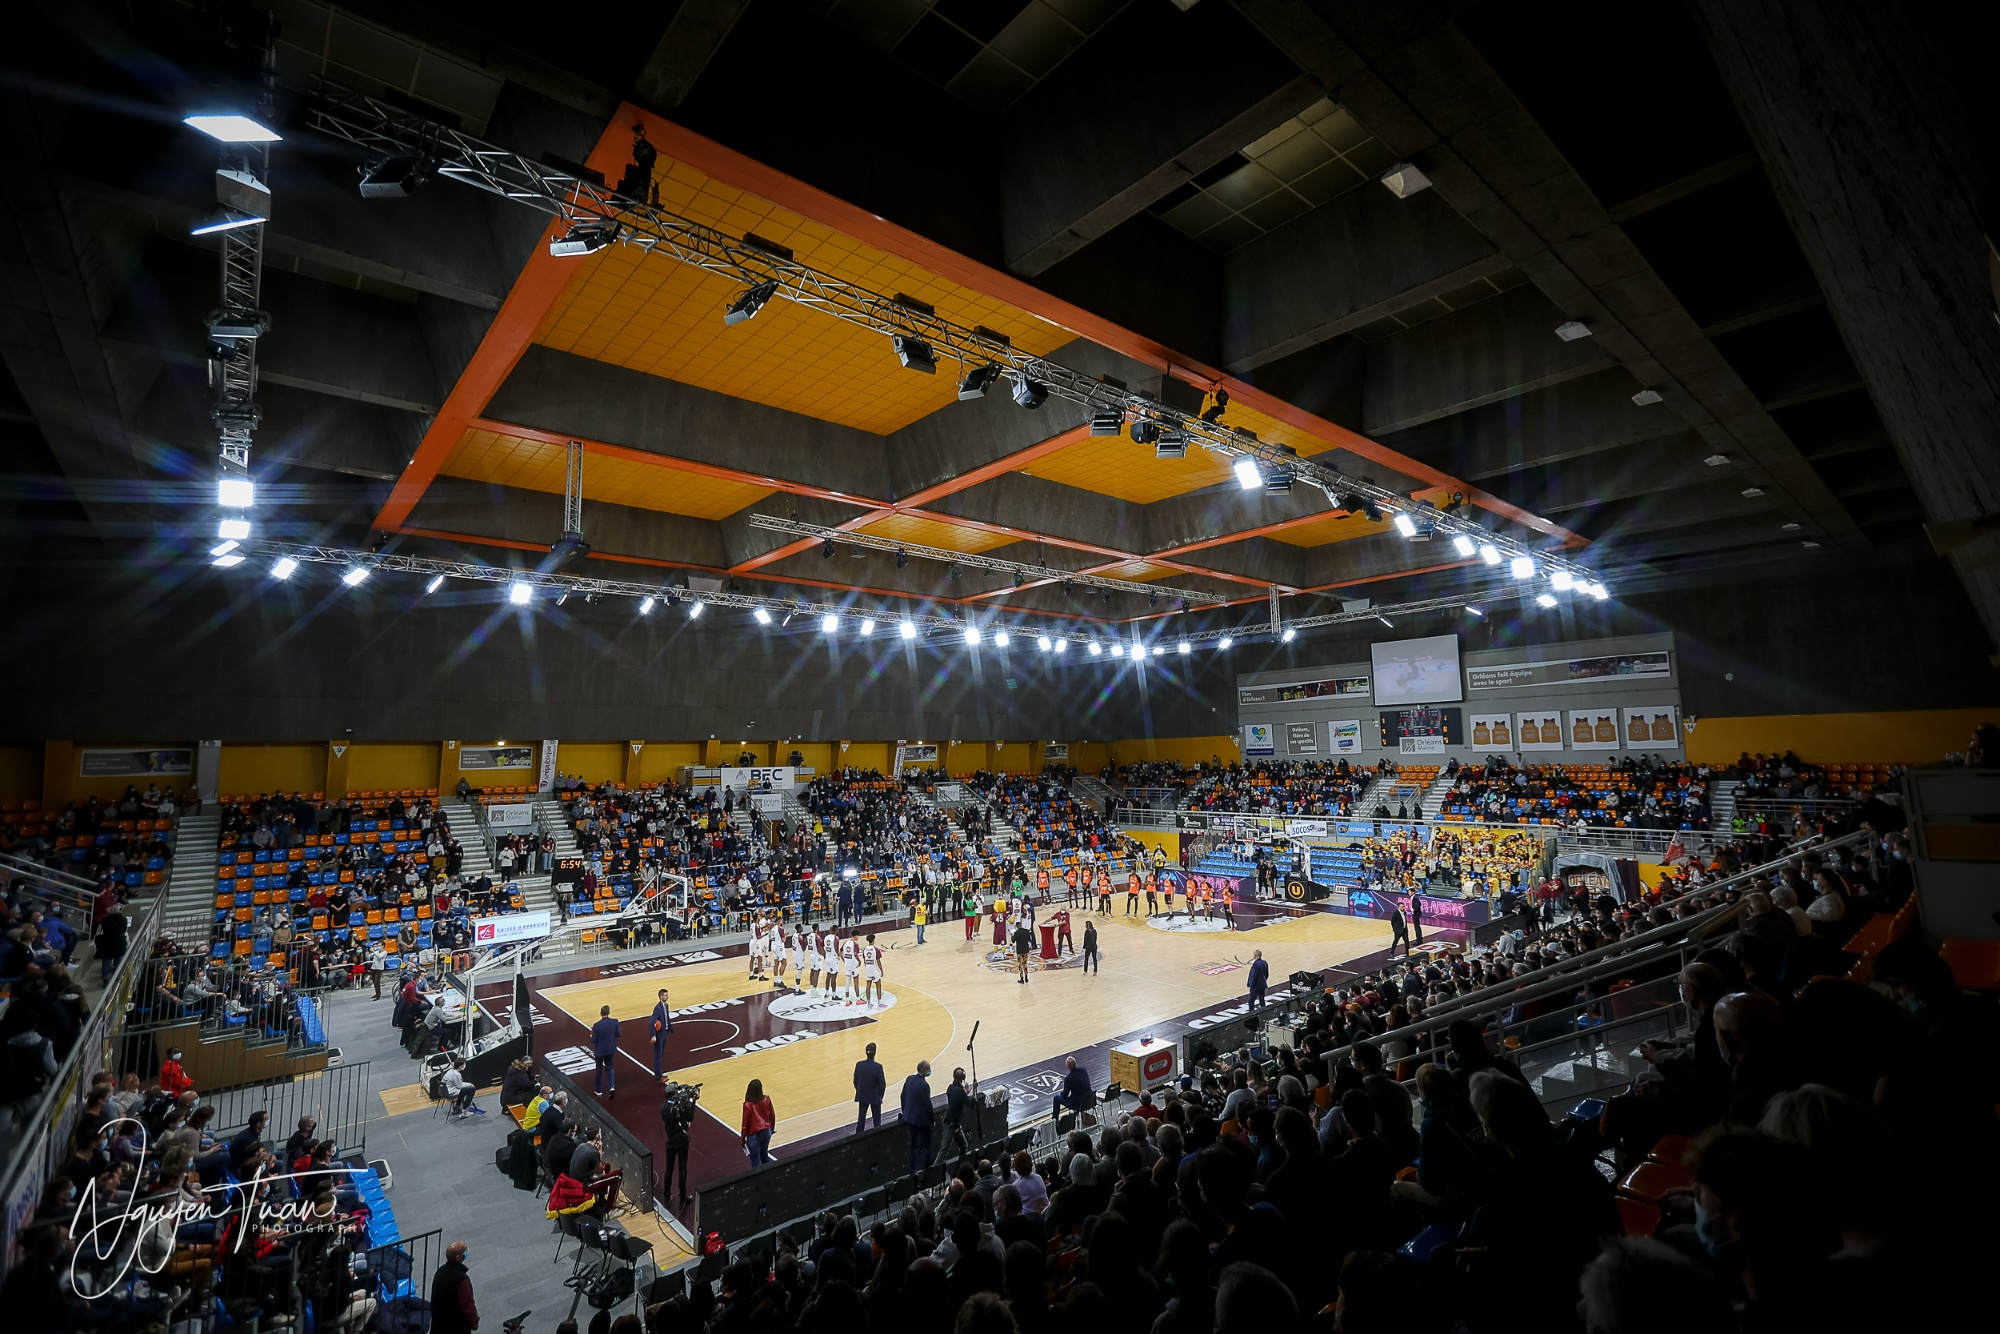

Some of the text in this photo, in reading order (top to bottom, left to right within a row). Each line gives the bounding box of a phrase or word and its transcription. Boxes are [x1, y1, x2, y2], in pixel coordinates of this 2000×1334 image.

[1472, 672, 1497, 680] Orléans
[1509, 669, 1533, 678] équipe
[1495, 678, 1513, 686] sport
[750, 768, 783, 781] BFC
[560, 860, 582, 869] 6:54
